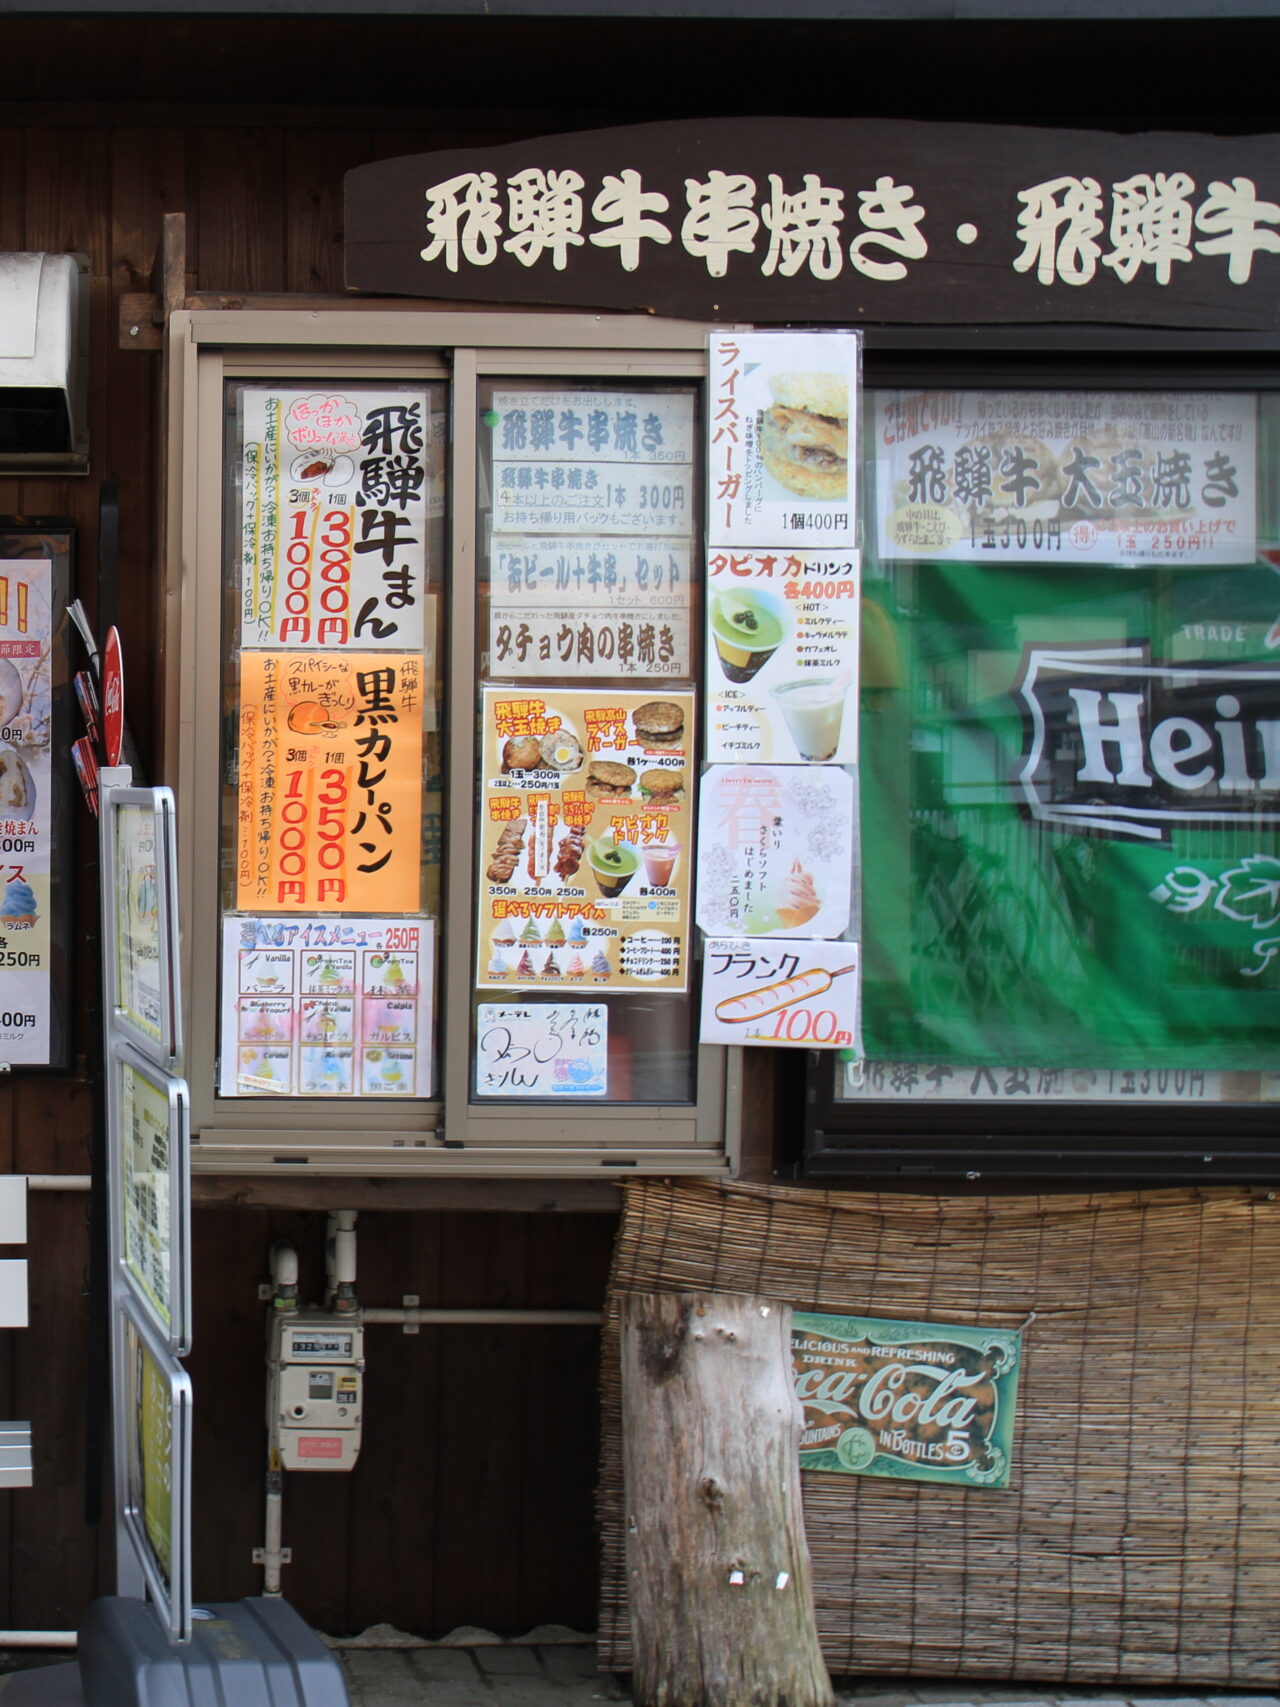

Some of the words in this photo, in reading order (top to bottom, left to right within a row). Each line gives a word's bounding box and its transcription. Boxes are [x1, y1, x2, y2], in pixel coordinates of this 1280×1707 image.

[502, 409, 663, 452] 飛騨牛串焼き
[712, 342, 742, 528] ライスバーガー
[649, 450, 685, 461] 350円
[500, 467, 599, 490] 飛騨牛串焼き
[908, 444, 1041, 508] 飛騨牛
[289, 489, 310, 503] 3個
[328, 493, 347, 505] 1個
[607, 483, 626, 509] 1本
[639, 484, 684, 510] 300円
[353, 401, 425, 640] 飛騨牛まん
[782, 513, 848, 530] 1個400円
[279, 510, 311, 643] 1000円
[317, 510, 351, 644] 380円
[784, 581, 855, 600] 各400円
[804, 617, 845, 625] ミルクティー
[804, 631, 848, 639] キャラメルラテ
[1182, 623, 1247, 642] TRADE
[804, 645, 838, 653] カフェオレ
[288, 659, 350, 674] スパイシーな
[646, 663, 681, 673] 250円
[804, 659, 840, 667] 抹茶ミルク
[288, 678, 339, 697] 黒カレーが
[399, 660, 420, 712] 飛騨牛
[318, 691, 355, 710] ぎっしり
[494, 700, 546, 720] 飛騨牛
[586, 722, 627, 737] ライス
[588, 737, 640, 752] バーガー
[285, 748, 307, 762] 3個
[325, 752, 345, 764] 1個
[350, 667, 398, 873] 黒カレーパン
[611, 813, 669, 828] タピオカ
[277, 770, 308, 904] 1000円
[317, 769, 347, 902] 350円
[613, 828, 669, 845] ドリンク
[758, 825, 768, 892] さくらソフト
[744, 847, 754, 913] はじめました
[489, 887, 517, 896] 350円
[524, 887, 552, 896] 250円
[556, 888, 584, 897] 250円
[639, 887, 676, 897] 各400円
[7, 922, 30, 930] ラムネ
[385, 927, 419, 950] 250円
[265, 955, 291, 963] Vanilla
[710, 953, 800, 980] フランク
[772, 1009, 852, 1046] 100円
[803, 1354, 857, 1367] DRINK
[871, 1345, 956, 1365] REFRESHING
